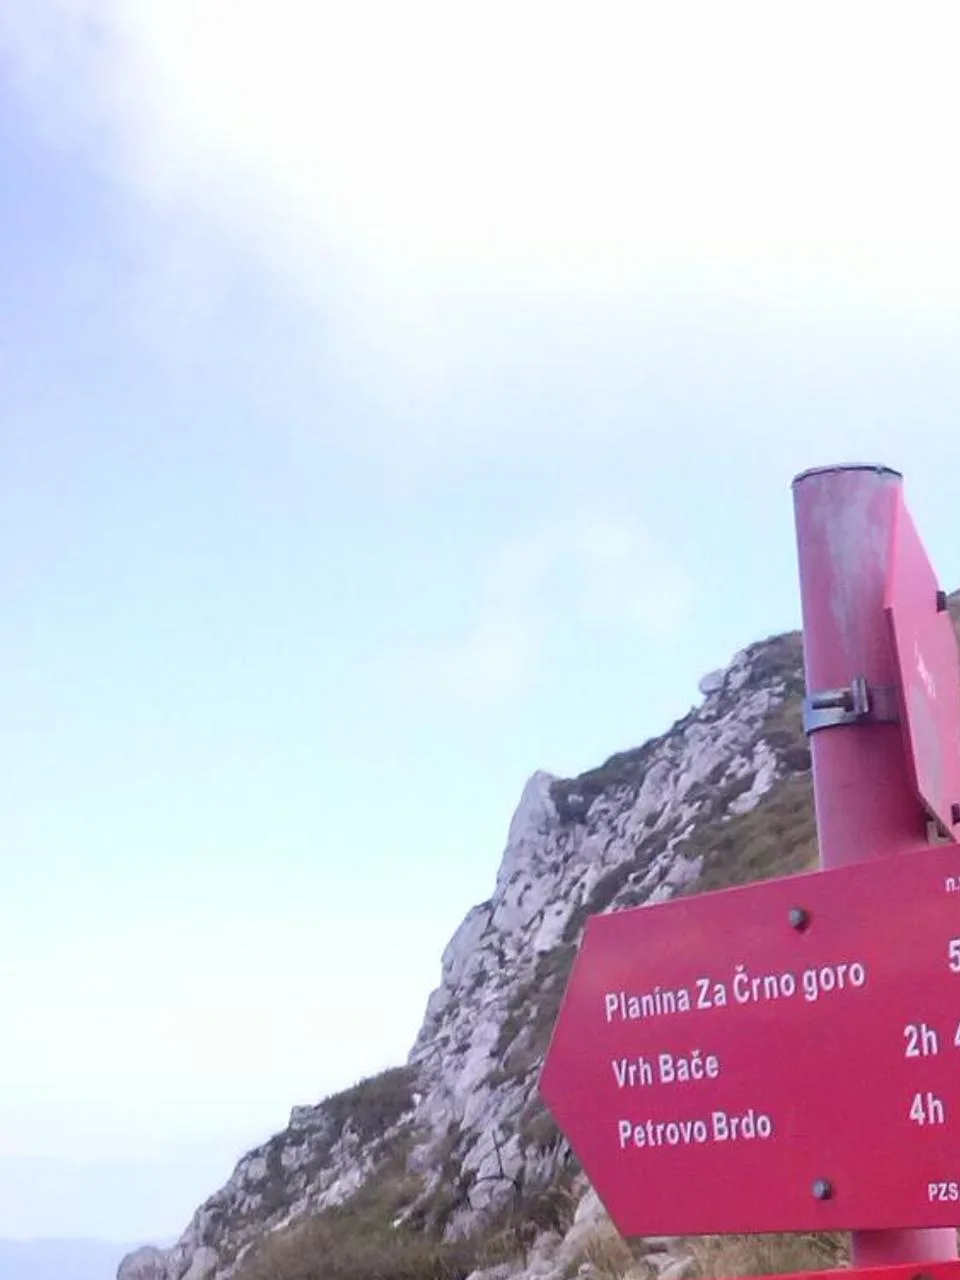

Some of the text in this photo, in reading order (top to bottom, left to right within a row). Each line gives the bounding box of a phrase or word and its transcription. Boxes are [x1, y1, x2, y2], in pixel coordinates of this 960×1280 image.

[604, 986, 691, 1023] Planina
[695, 978, 727, 1010] Za
[732, 964, 796, 1004] Črno
[802, 962, 865, 1002] goro
[611, 1056, 653, 1089] Vrh
[658, 1049, 719, 1084] Bače
[903, 1023, 938, 1058] 2h
[618, 1091, 945, 1149] Petrovo Brdo 4h
